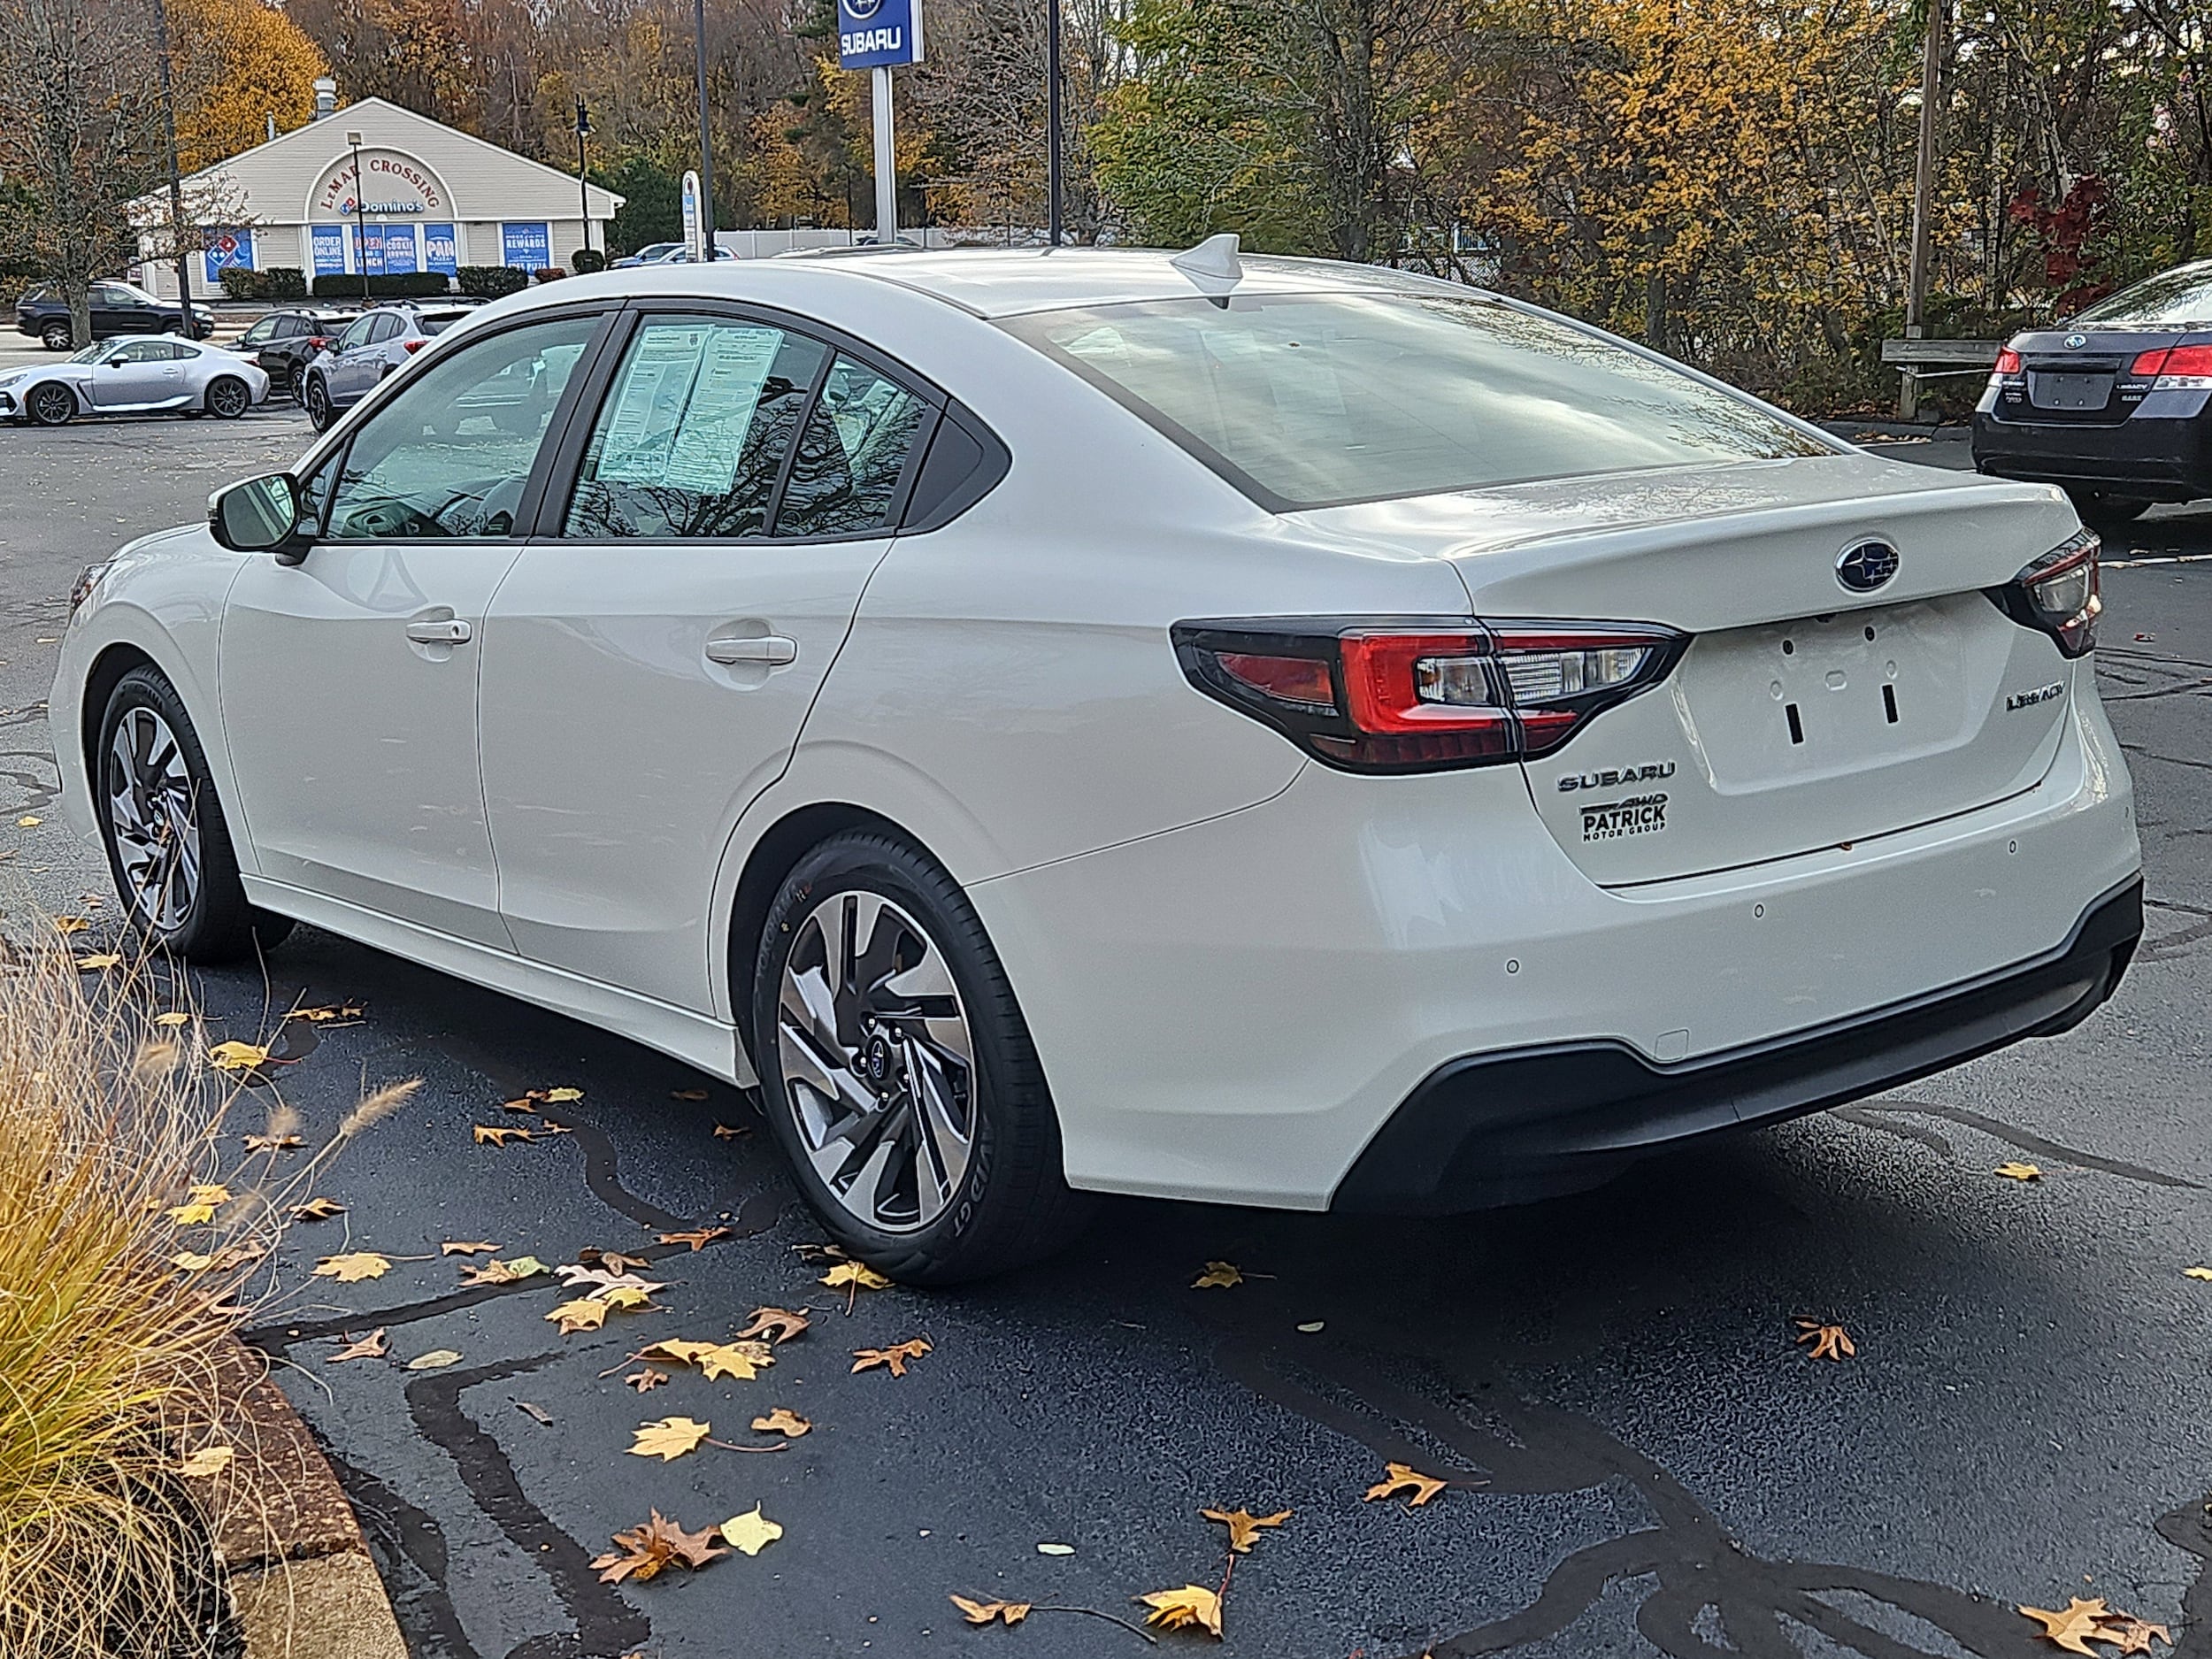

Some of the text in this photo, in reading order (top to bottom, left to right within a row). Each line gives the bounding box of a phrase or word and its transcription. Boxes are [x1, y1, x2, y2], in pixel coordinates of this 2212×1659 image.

[841, 26, 901, 56] SUBARU
[370, 159, 440, 209] CROSSING
[360, 199, 424, 212] Domino's
[313, 236, 342, 247] ORDER
[426, 240, 455, 257] PAN
[506, 238, 546, 249] REWARDS
[314, 247, 342, 257] ONLINE
[2006, 680, 2065, 711] LEGACY
[1558, 762, 1676, 792] SUBARU
[1584, 804, 1667, 833] PATRICK
[1583, 822, 1666, 842] MOTOR GROUP
